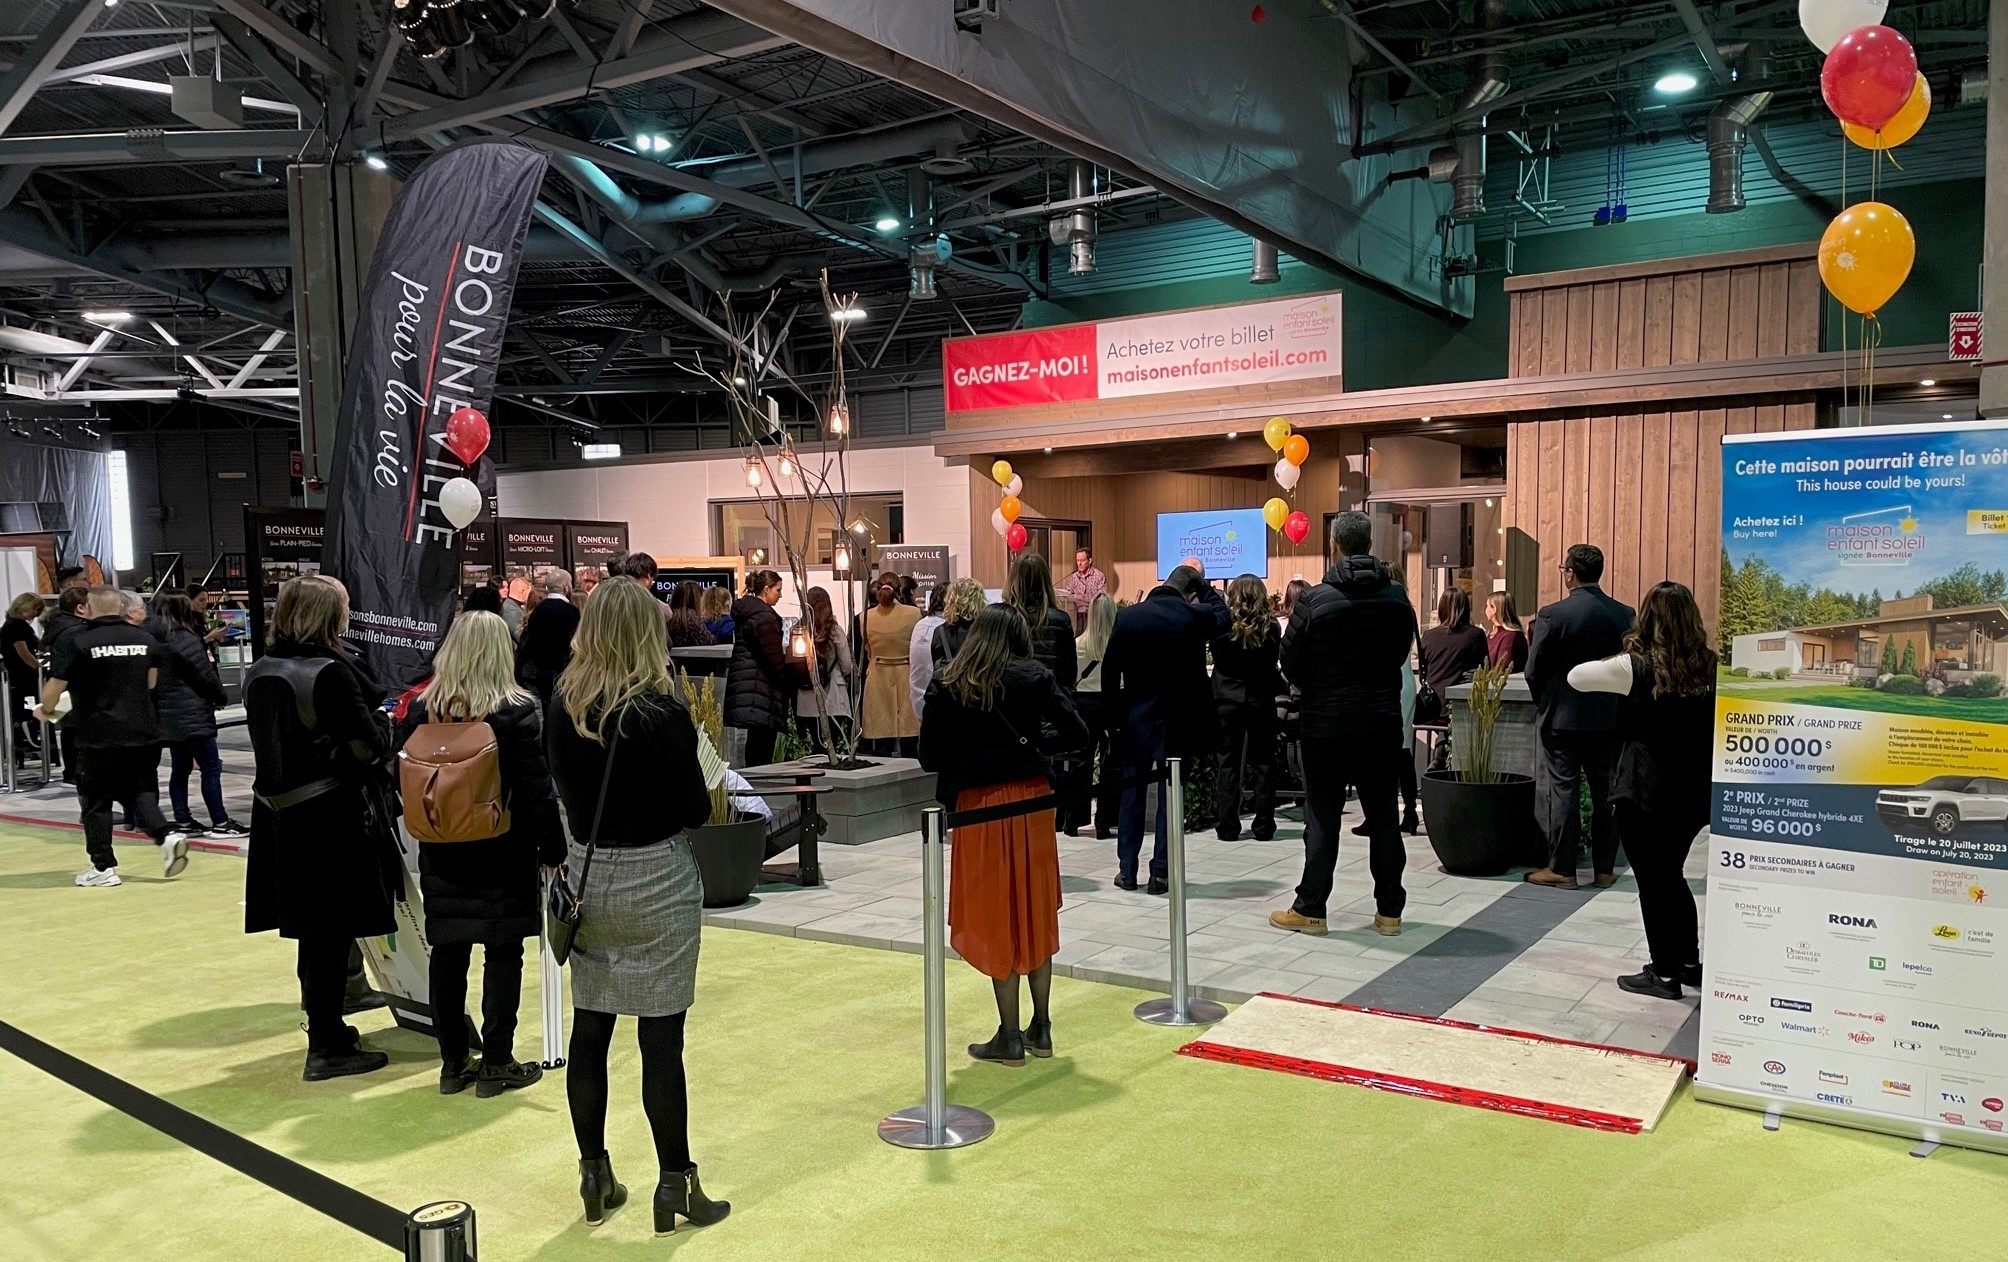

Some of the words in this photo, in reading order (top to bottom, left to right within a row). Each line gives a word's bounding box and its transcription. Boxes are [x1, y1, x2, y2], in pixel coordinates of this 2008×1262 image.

[390, 271, 429, 369] pour
[1283, 311, 1318, 321] maison
[1106, 340, 1174, 360] Achetez
[1180, 332, 1225, 351] votre
[1231, 325, 1275, 346] billet
[1107, 349, 1328, 384] maisonenfantsoleil.com
[384, 379, 428, 421] la
[416, 244, 503, 550] BONNEVILLE
[374, 430, 409, 488] vie
[1735, 460, 1776, 475] Cette
[1780, 456, 1839, 473] maison
[1844, 452, 1914, 475] pourrait
[1918, 450, 1955, 468] être
[1960, 449, 1976, 466] la
[1981, 447, 2008, 465] vôt
[1796, 479, 1820, 491] This
[1824, 478, 1862, 490] house
[1865, 476, 1901, 489] could
[1905, 475, 1921, 488] be
[1925, 473, 1965, 491] yours!
[1733, 516, 1780, 527] Achetez
[1783, 515, 1796, 526] ici
[1981, 514, 2004, 522] Billet
[265, 525, 325, 536] BONNEVILLE
[1733, 530, 1750, 539] Buy
[1752, 529, 1777, 538] here!
[1828, 525, 1893, 537] maison
[508, 533, 555, 543] BONNEVILLE
[577, 535, 619, 545] BONNEVILLE
[1180, 535, 1221, 546] maison
[1827, 536, 1878, 551] enfant
[1881, 536, 1925, 550] soleil
[886, 551, 941, 560] BONNEVILLE
[1180, 545, 1213, 557] enfant
[1214, 544, 1243, 555] soleil
[912, 571, 937, 580] Mission
[349, 611, 437, 633] sonsbonneville.com
[342, 628, 435, 651] nnevillehomes.com
[1726, 712, 1764, 725] GRAND
[1767, 714, 1795, 727] PRIX
[1804, 718, 1836, 729] GRAND
[1838, 720, 1863, 731] PRIZE
[1807, 763, 1835, 773] argent
[1736, 790, 1765, 805] PRIX
[1786, 798, 1809, 808] PRIZE
[1722, 804, 1738, 813] 2023
[1738, 805, 1755, 816] Jeep
[1756, 807, 1780, 817] Grand
[1781, 809, 1817, 819] Cherokee
[1818, 811, 1847, 823] hybride
[1848, 814, 1864, 823] 4XE
[1894, 834, 1926, 846] Tirage
[1928, 837, 1937, 846] le
[1939, 839, 1951, 847] 20
[1952, 840, 1981, 850] juillet
[1983, 844, 2008, 852] 2023
[1906, 845, 1928, 854] Draw
[1941, 849, 1958, 859] July
[1959, 851, 1971, 860] 20,
[1973, 852, 1994, 861] 2023
[1720, 850, 1746, 869] 38
[1749, 855, 1766, 864] PRIX
[1767, 856, 1817, 868] SECONDAIRES
[1818, 859, 1824, 868] À
[1825, 861, 1856, 872] GAGNER
[1932, 870, 1978, 881] opération
[1932, 879, 1963, 888] enfant
[1734, 902, 1782, 913] BONNEVILLE
[404, 900, 420, 932] ardins
[1828, 914, 1878, 929] RONA
[1714, 991, 1749, 1002] RE/MAX
[1738, 1014, 1765, 1024] OPTO
[1911, 1020, 1941, 1031] RONA
[1781, 1021, 1816, 1034] Walmart
